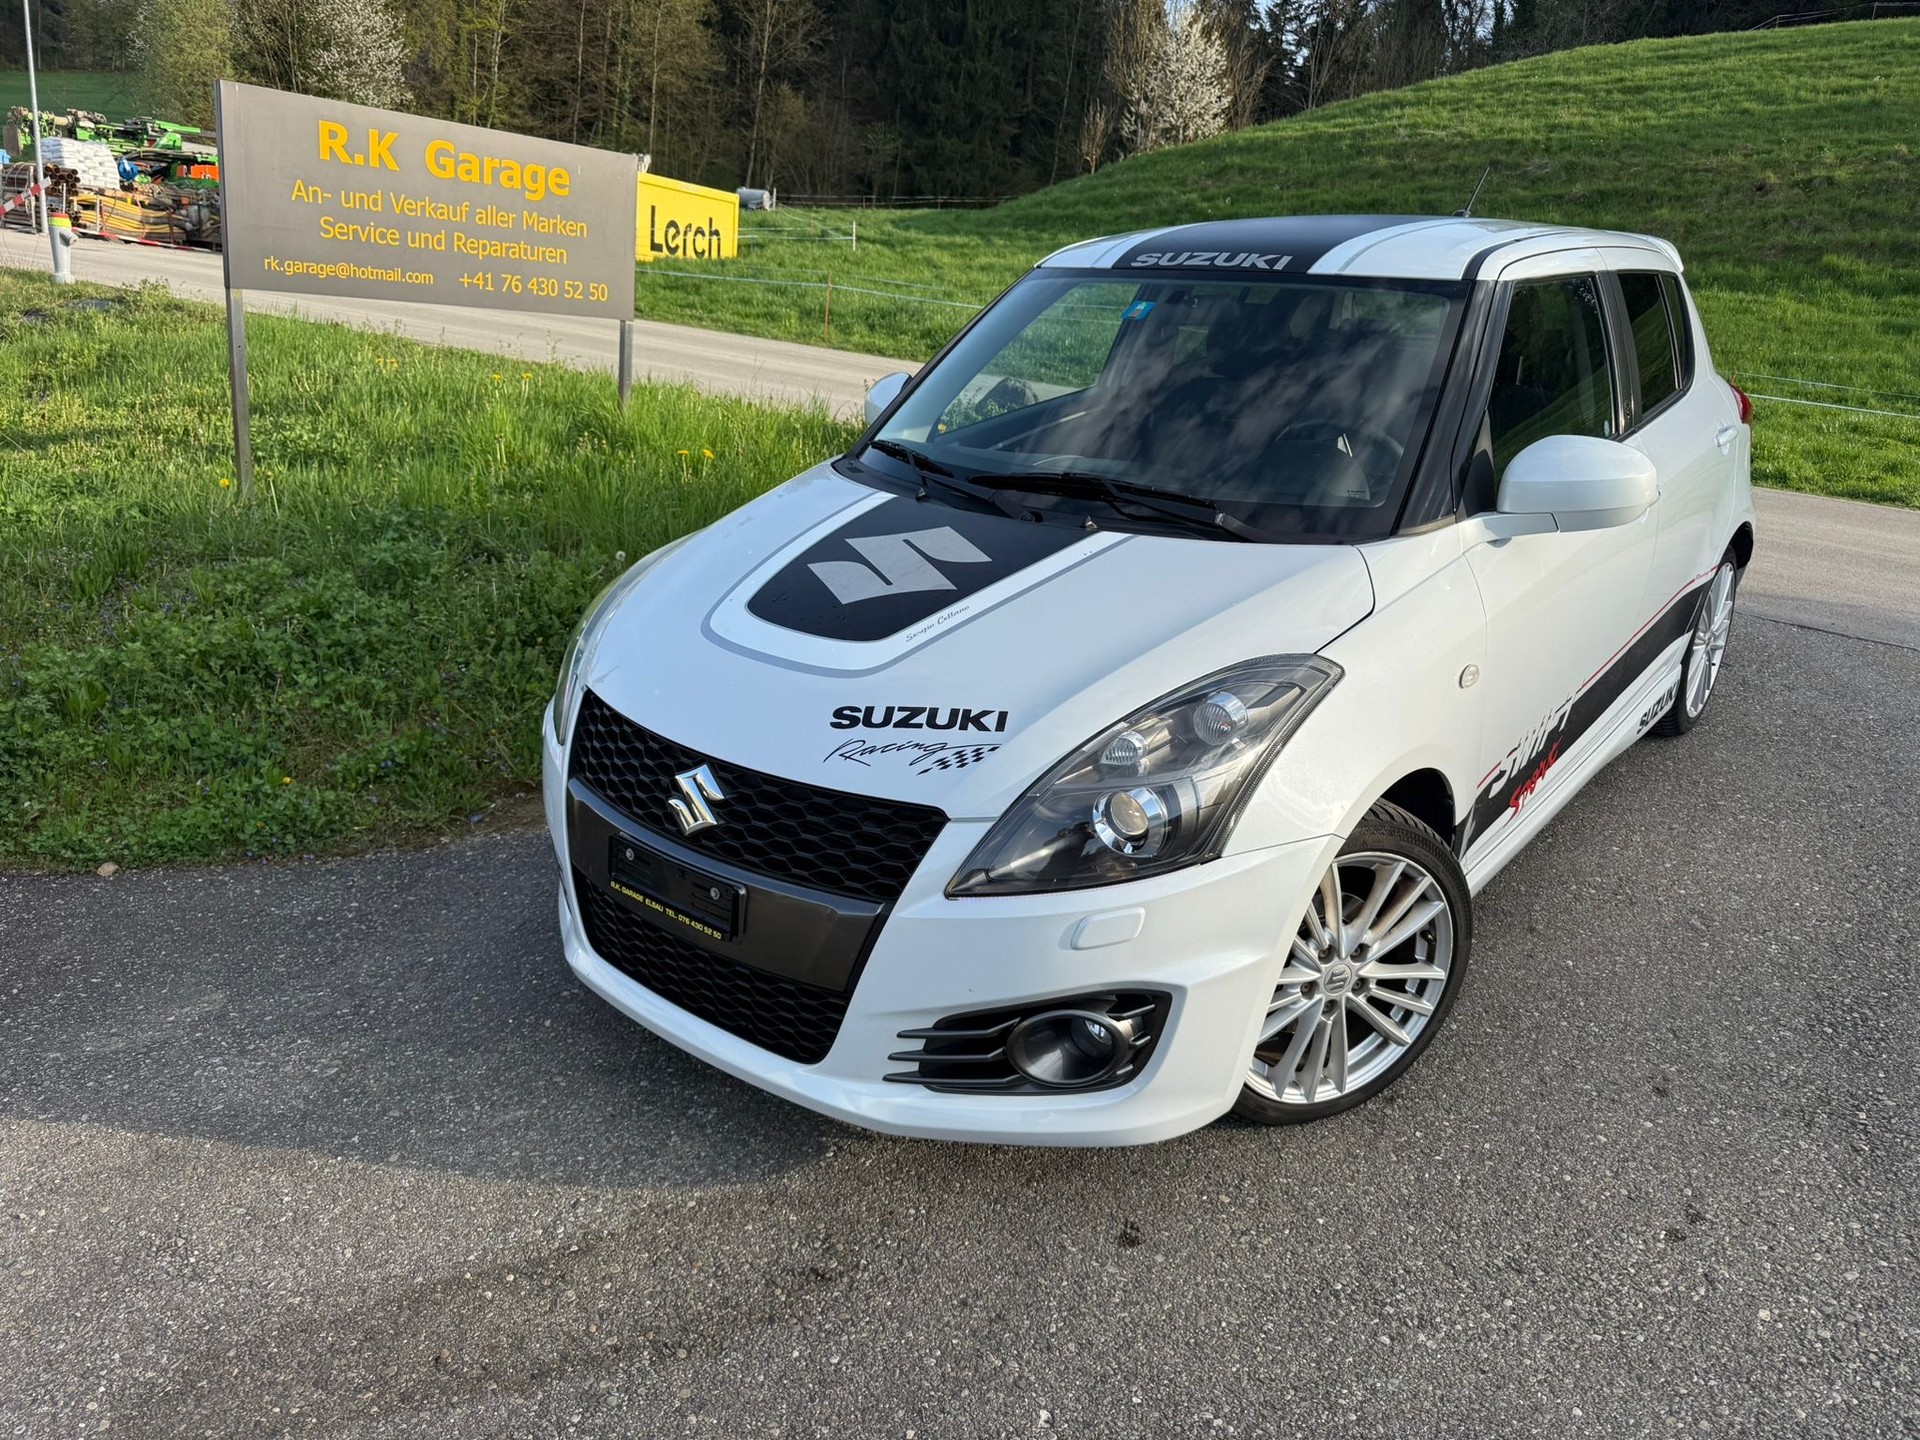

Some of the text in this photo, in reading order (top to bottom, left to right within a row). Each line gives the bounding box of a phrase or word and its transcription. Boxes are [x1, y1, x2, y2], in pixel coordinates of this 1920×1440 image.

[318, 119, 570, 201] R.K Garage
[291, 179, 588, 238] An- und Verkauf aller Marken
[650, 204, 721, 260] Lerch
[319, 215, 568, 264] Service und Reparaturen
[1130, 251, 1293, 271] SUZUKI
[264, 255, 609, 302] rk.garage@hotmail.com +41 76 430 52 50
[905, 623, 935, 642] Sergio
[829, 705, 1009, 732] SUZUKI
[1636, 679, 1680, 735] SUZUKI
[823, 738, 1002, 767] Racing
[621, 886, 643, 902] GARAGE
[678, 914, 690, 925] 076
[690, 920, 703, 931] 430
[703, 926, 713, 936] 52
[712, 930, 722, 940] 50
